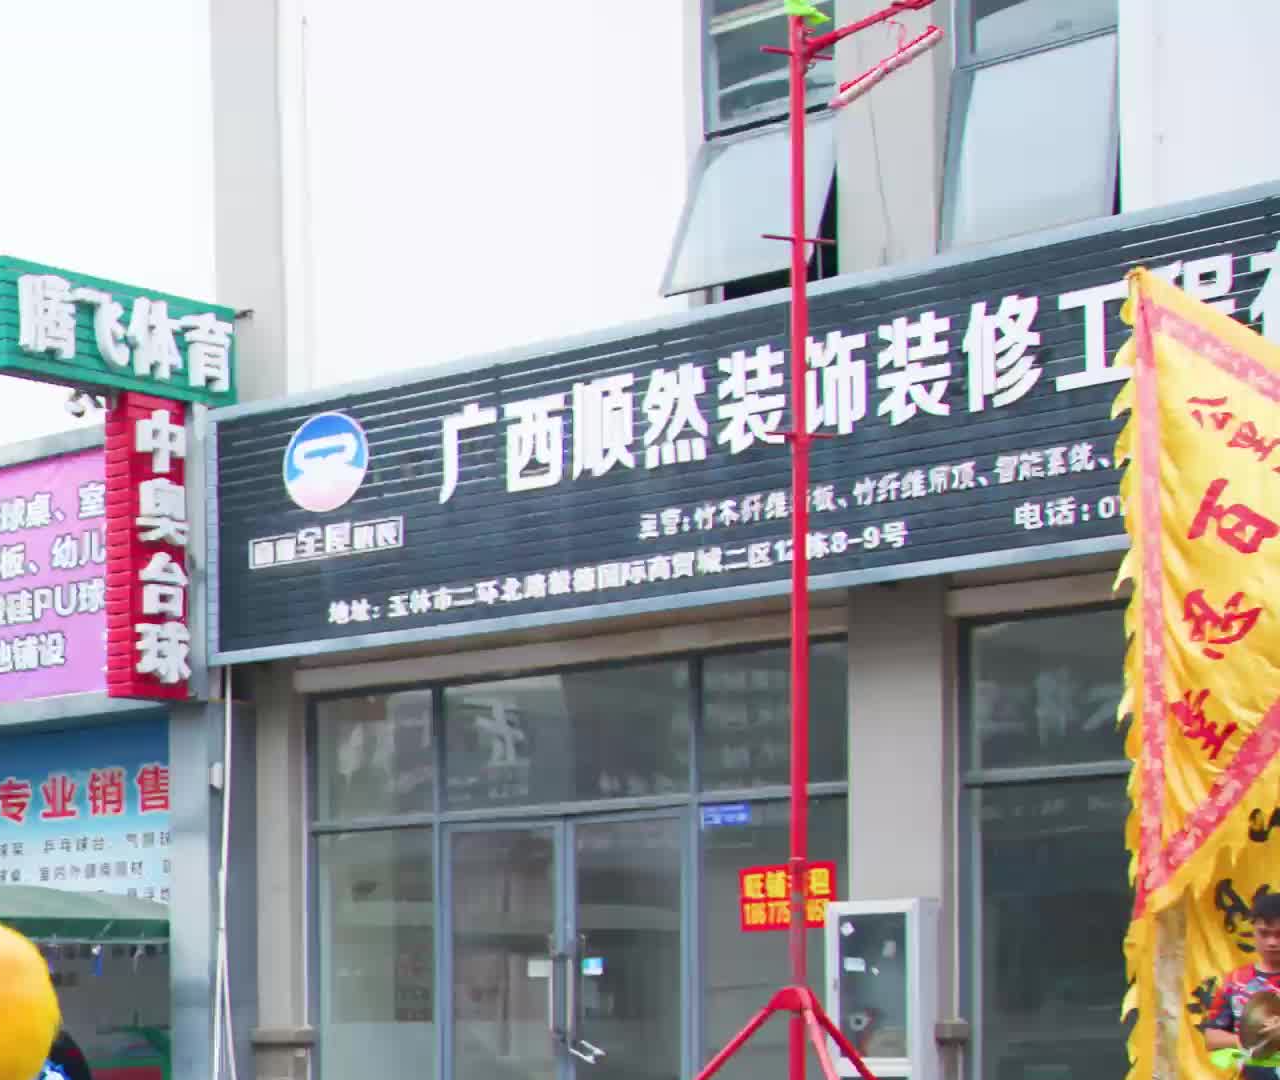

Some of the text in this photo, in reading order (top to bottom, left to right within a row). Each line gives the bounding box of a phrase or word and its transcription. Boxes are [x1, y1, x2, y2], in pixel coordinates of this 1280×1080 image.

[17, 274, 233, 393] 腾飞体育
[135, 410, 191, 684] 中奥台球
[744, 868, 831, 898] 旺铺租
